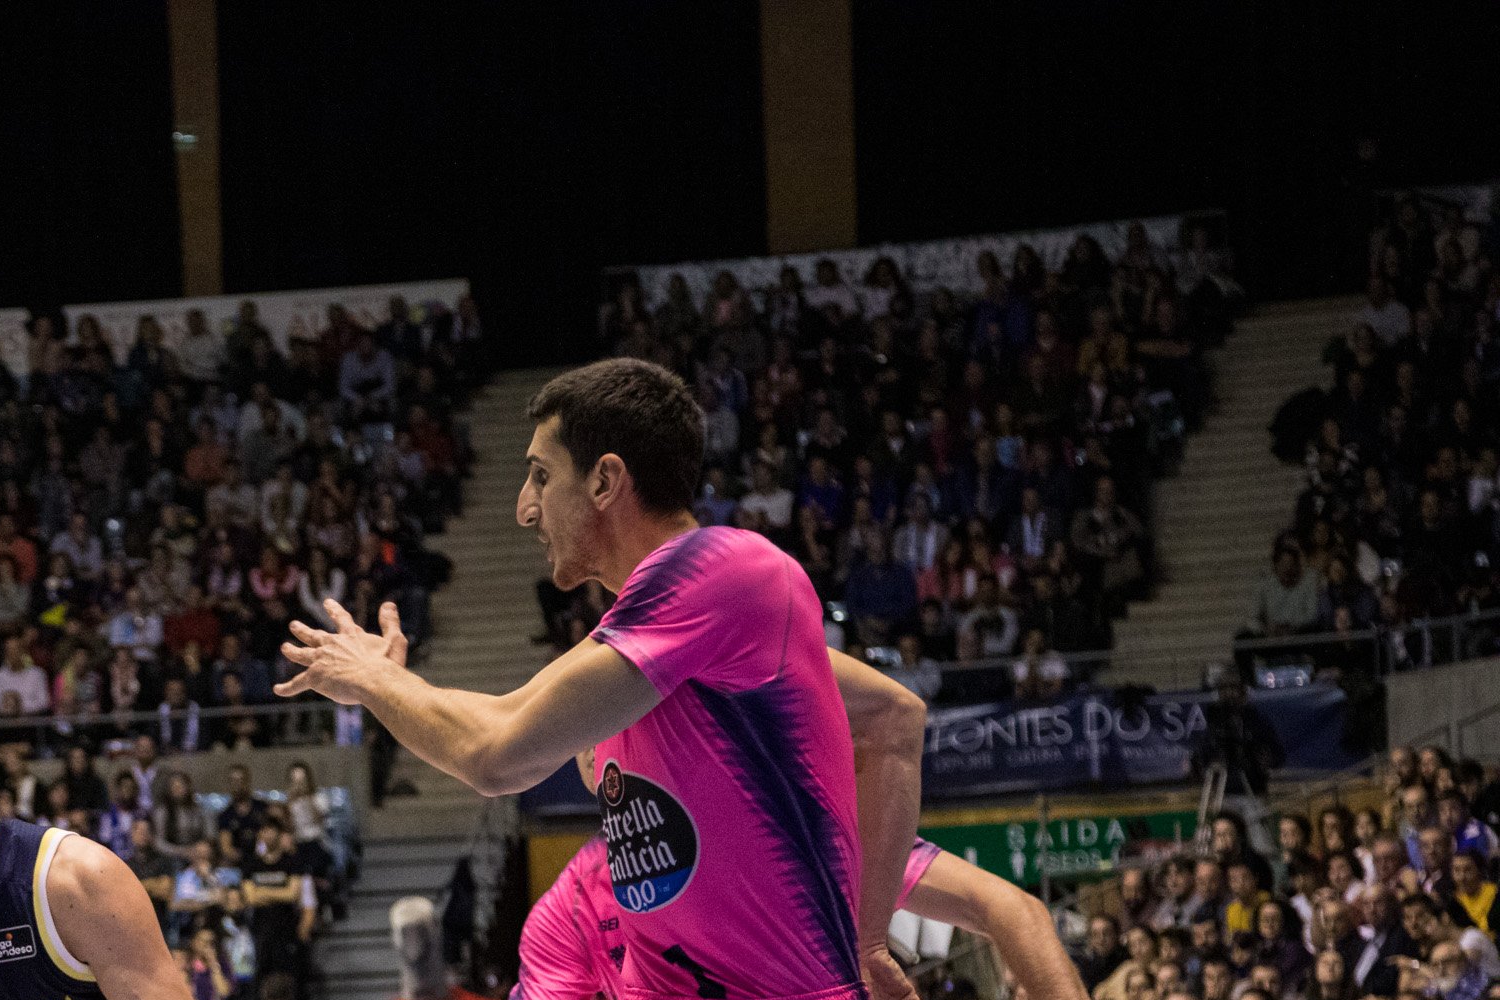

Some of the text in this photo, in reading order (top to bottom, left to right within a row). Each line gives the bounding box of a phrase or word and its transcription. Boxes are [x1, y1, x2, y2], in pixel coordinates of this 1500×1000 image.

[1161, 701, 1208, 740] SA
[602, 797, 665, 843] strella
[608, 835, 677, 881] alicia
